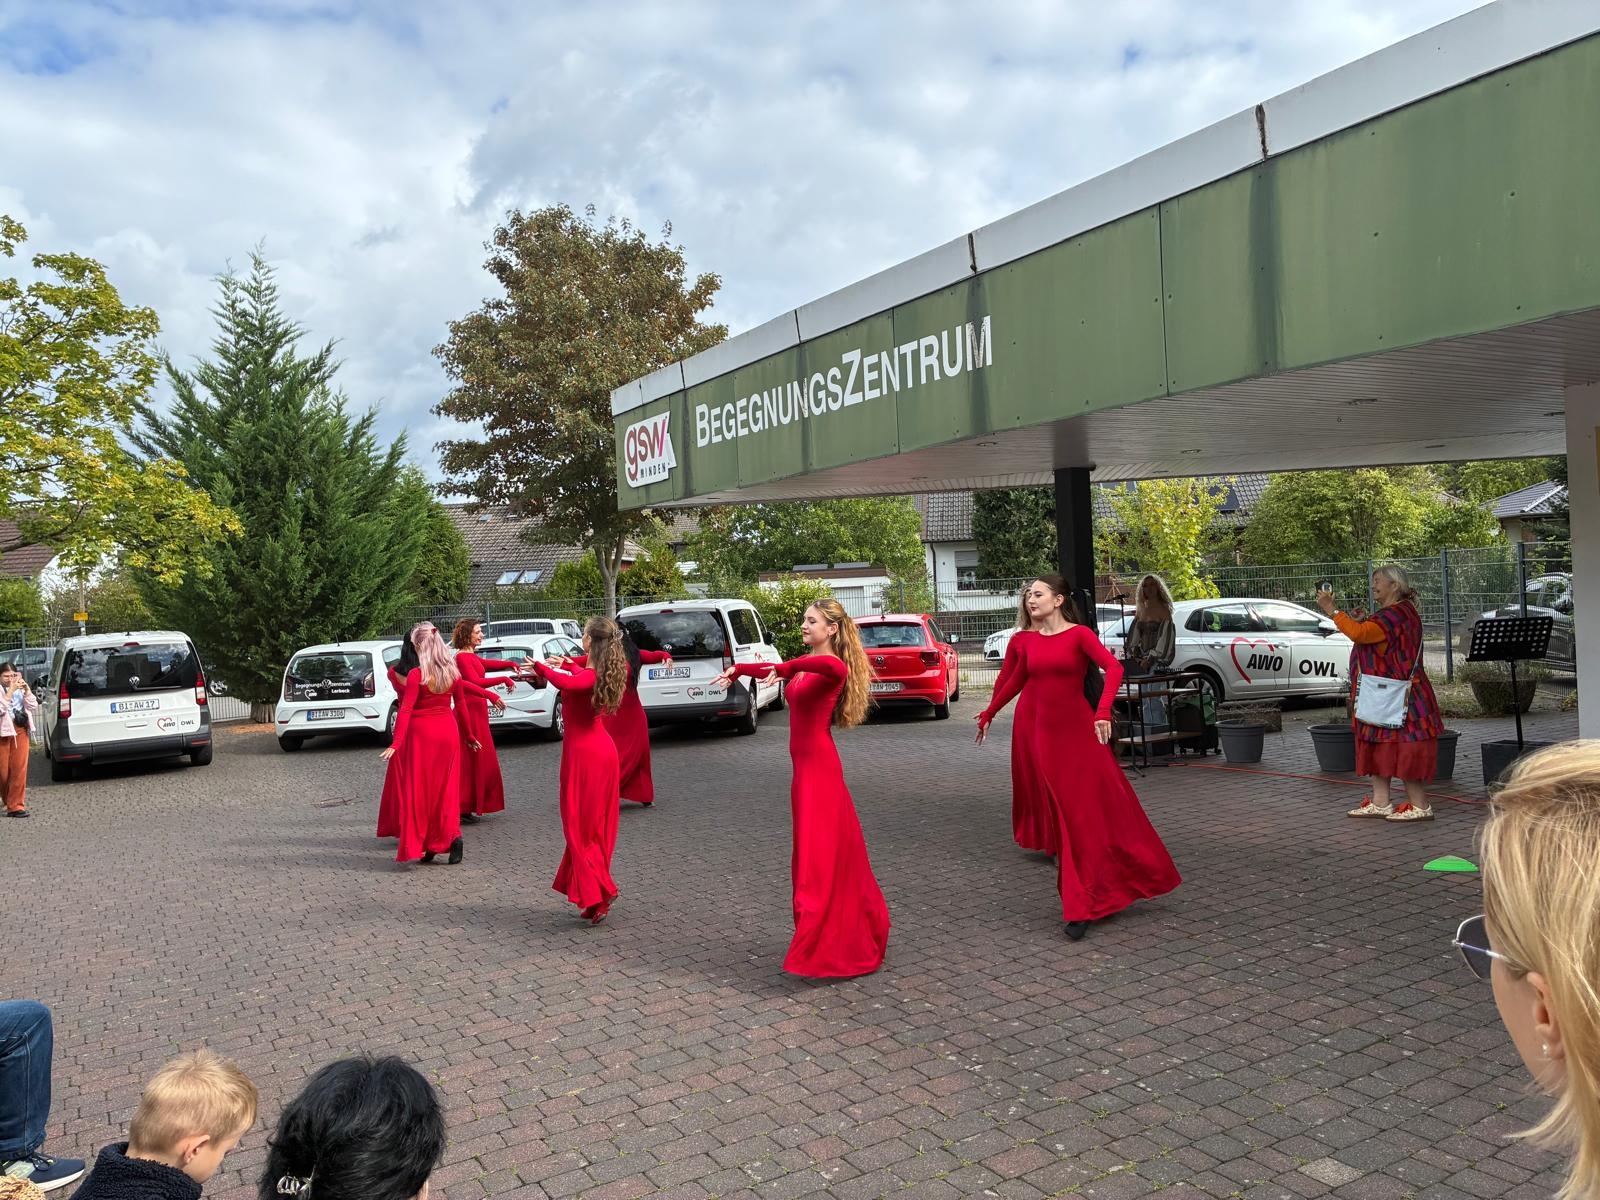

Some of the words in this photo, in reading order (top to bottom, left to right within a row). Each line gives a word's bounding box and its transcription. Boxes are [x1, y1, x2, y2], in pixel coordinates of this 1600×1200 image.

[626, 418, 666, 482] gsw
[640, 462, 666, 479] MINDEN
[1246, 653, 1284, 672] AWO
[1298, 659, 1338, 678] OWL
